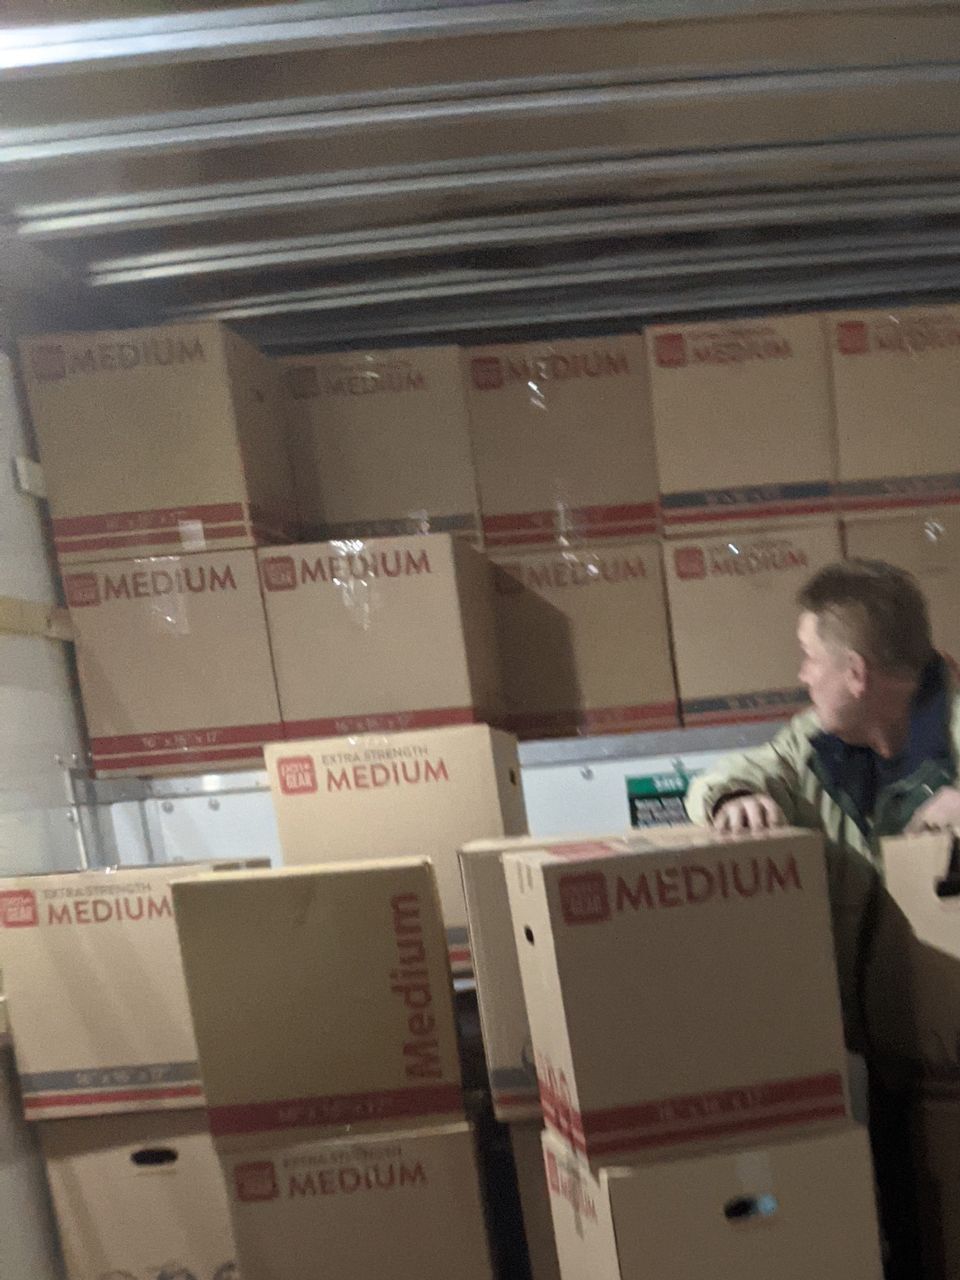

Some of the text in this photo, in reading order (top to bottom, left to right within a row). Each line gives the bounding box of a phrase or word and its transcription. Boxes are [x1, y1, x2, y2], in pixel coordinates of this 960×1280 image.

[103, 565, 237, 601] MEDIUM
[300, 549, 431, 584] MEDIUM
[326, 757, 449, 792] MEDIUM
[615, 853, 803, 911] MEDIUM
[48, 896, 175, 926] MEDIUM
[390, 892, 444, 1079] Medium
[288, 1160, 428, 1197] MEDIUM
